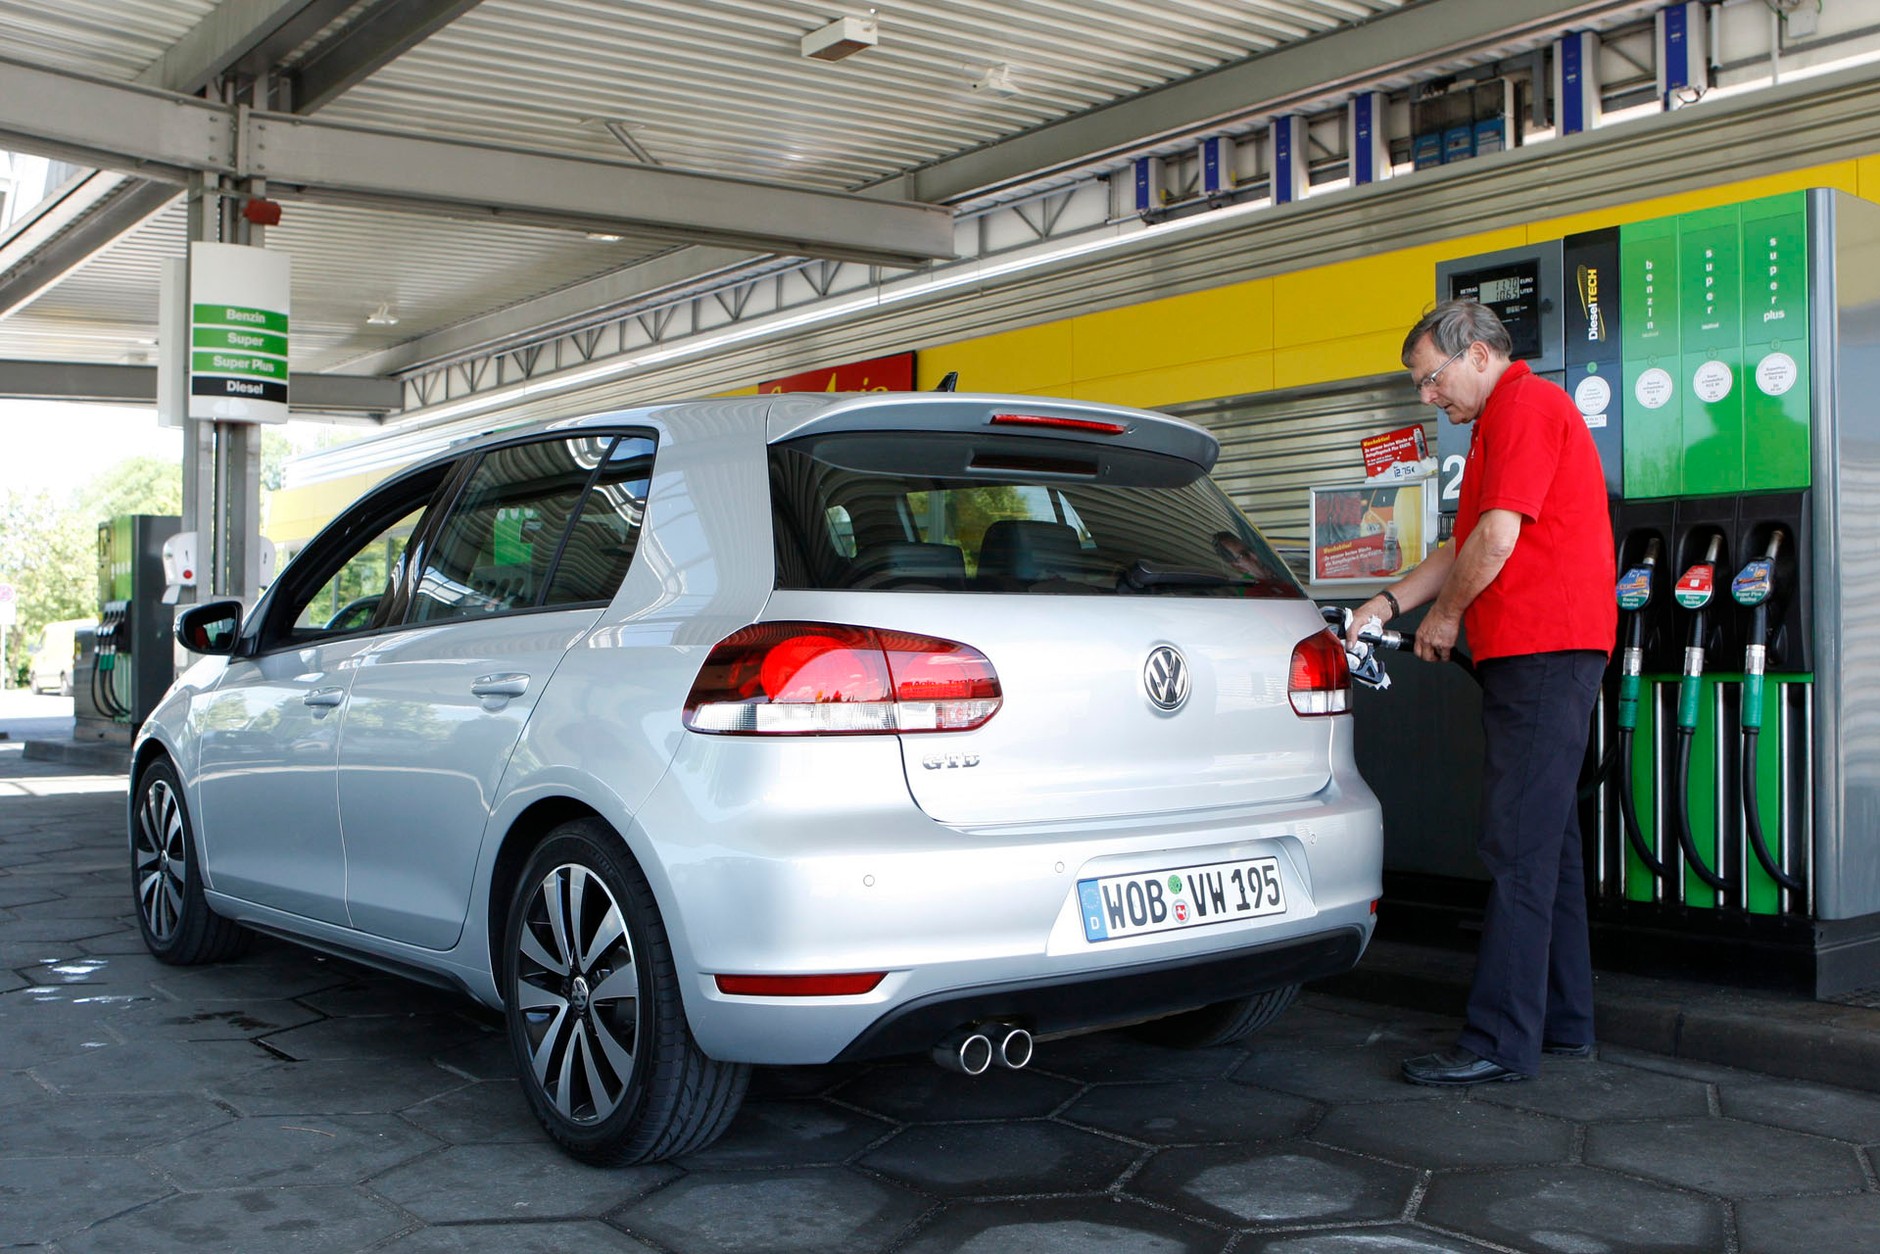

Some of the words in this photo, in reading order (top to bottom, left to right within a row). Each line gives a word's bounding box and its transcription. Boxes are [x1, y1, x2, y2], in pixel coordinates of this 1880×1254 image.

[1769, 237, 1777, 305] super
[1705, 249, 1713, 315] super
[1645, 260, 1654, 329] benzin
[1586, 268, 1599, 341] DieselTECH
[226, 308, 266, 324] Benzin
[1763, 309, 1785, 323] plus
[227, 332, 264, 347] Super
[213, 355, 250, 369] Super
[251, 359, 275, 372] Plus
[226, 380, 264, 394] Diesel
[1442, 454, 1466, 500] 2
[922, 752, 980, 770] GTD
[1102, 879, 1167, 930] WOB
[1187, 871, 1227, 917] VW
[1230, 865, 1280, 911] 195
[1090, 916, 1099, 930] D
